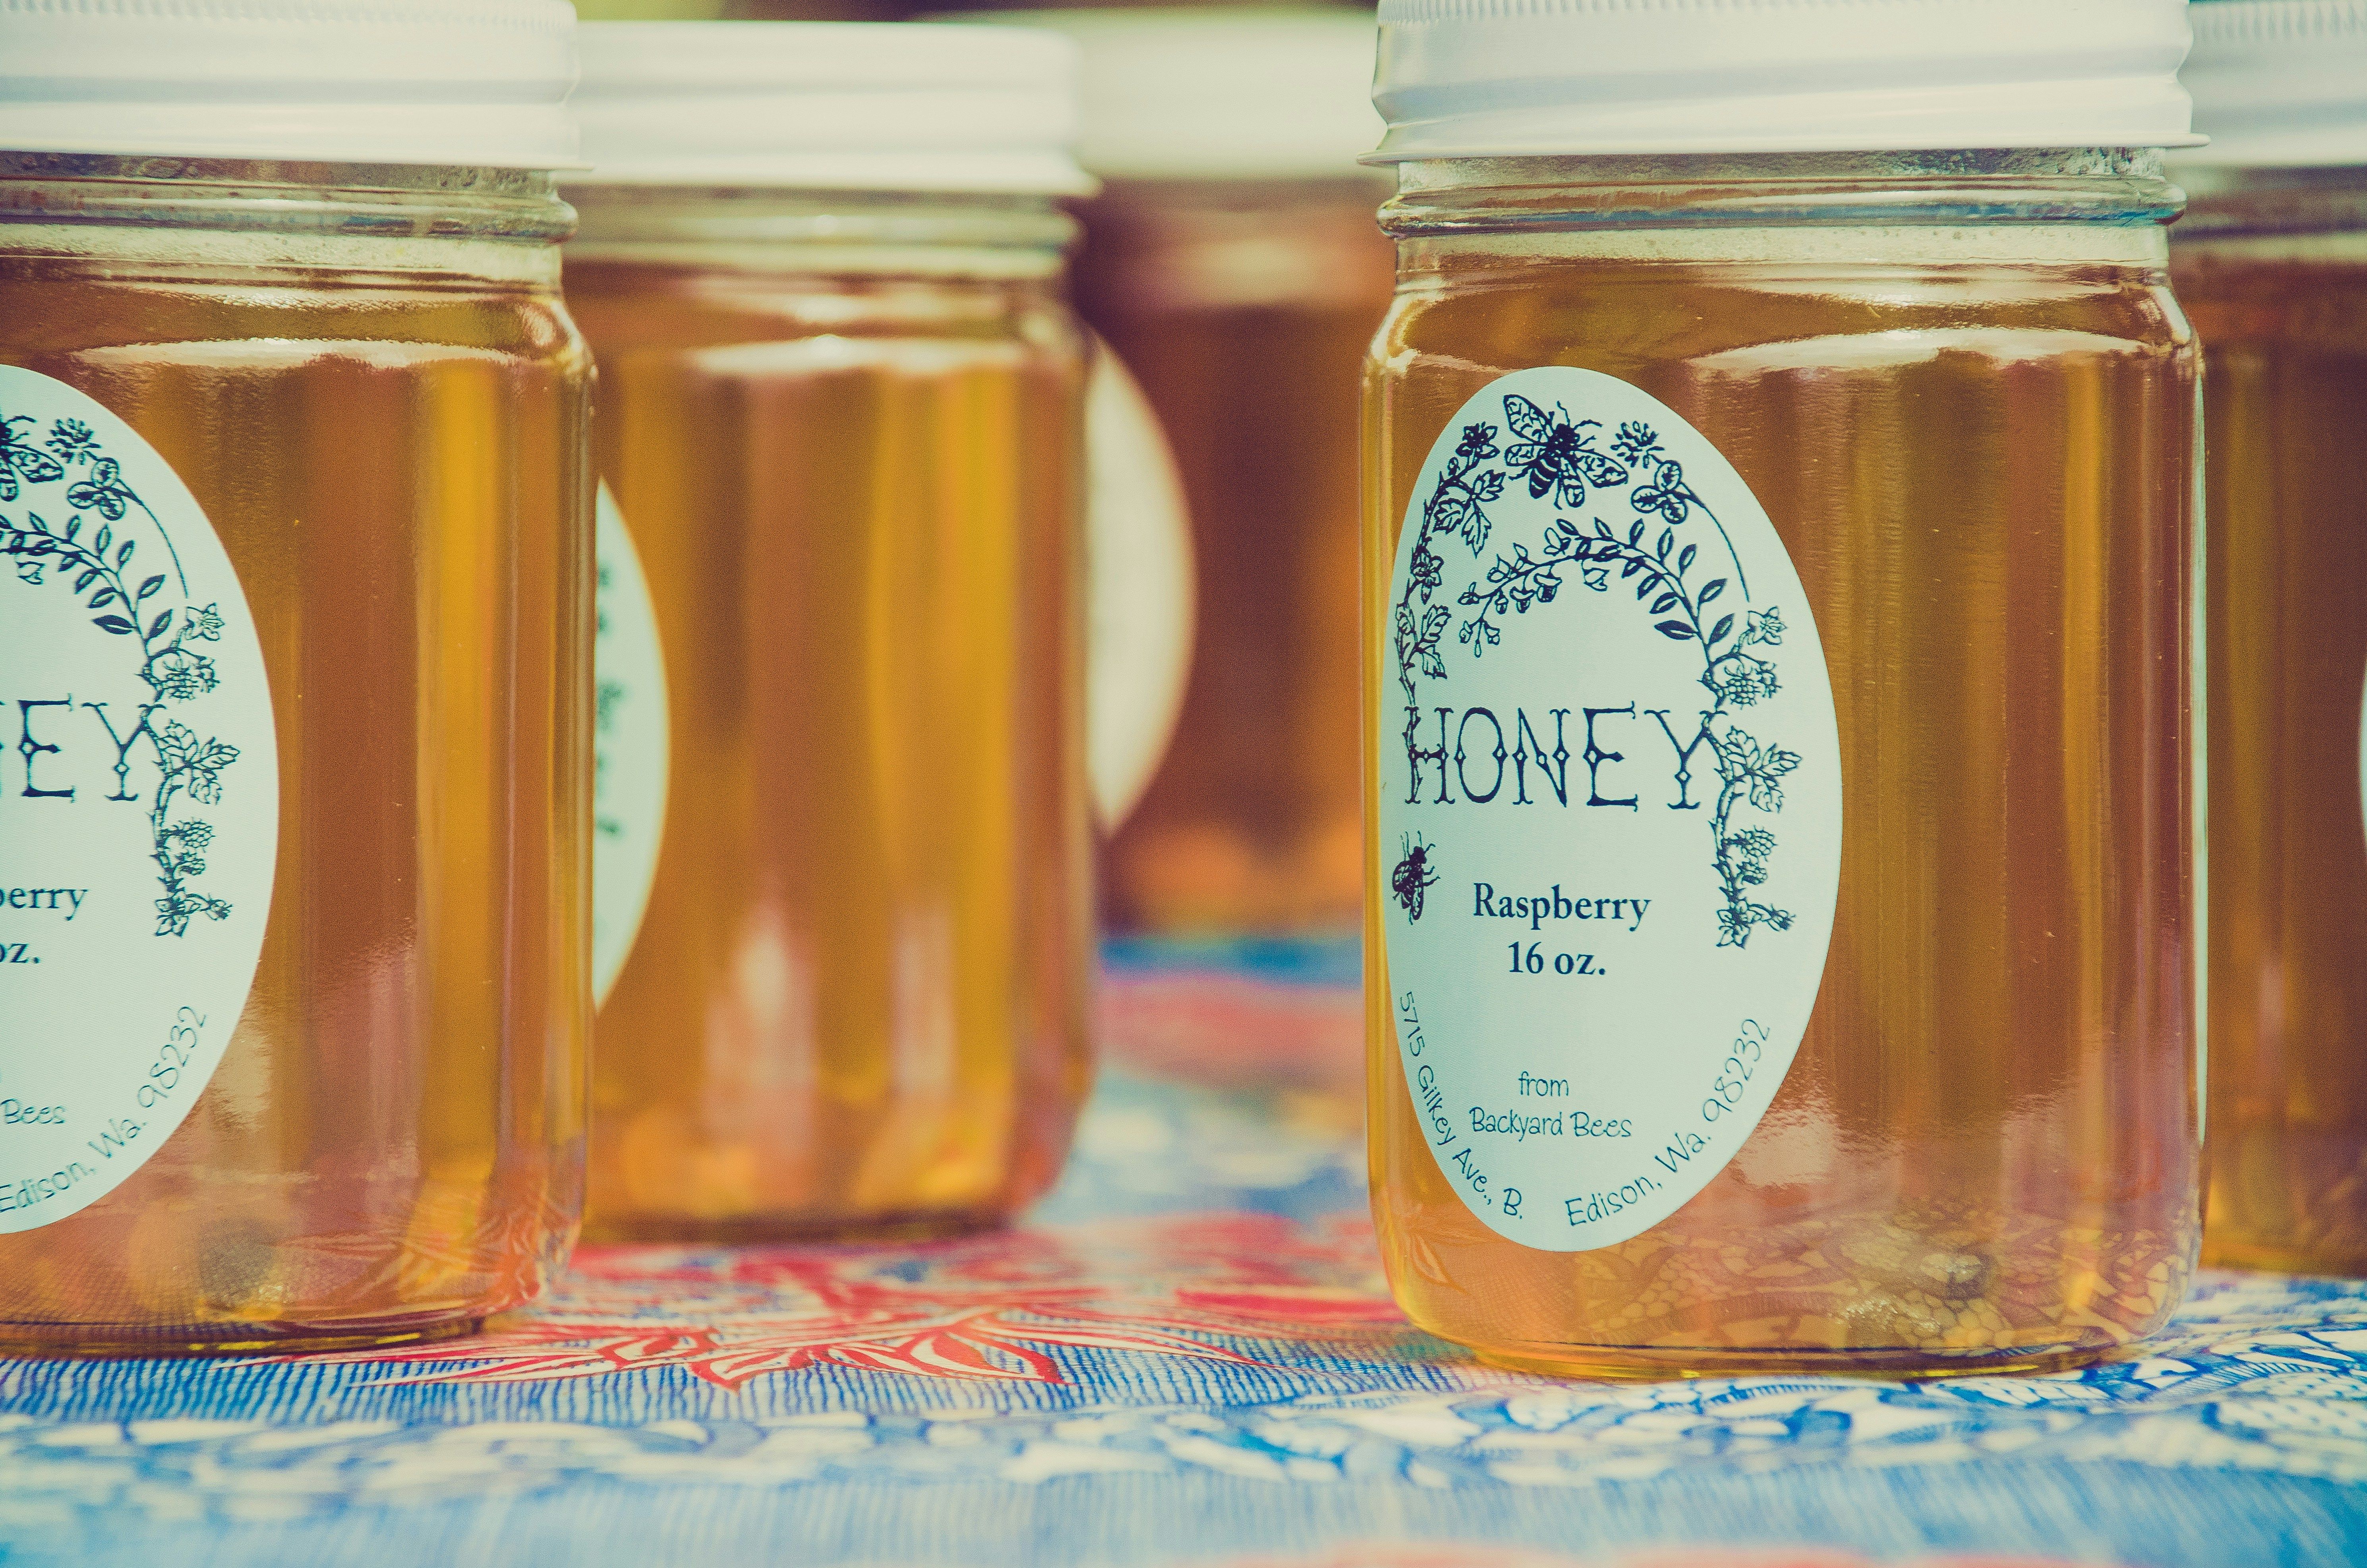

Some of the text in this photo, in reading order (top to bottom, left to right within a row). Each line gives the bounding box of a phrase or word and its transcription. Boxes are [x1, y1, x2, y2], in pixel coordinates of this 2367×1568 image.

[0, 692, 166, 803] EY
[1404, 701, 1728, 812] HONEY
[0, 888, 89, 921] erry
[1473, 882, 1652, 931] Raspberry
[1508, 941, 1605, 976] 16 oz.
[87, 1119, 147, 1159] Wa.
[137, 1006, 207, 1108] 98232
[1518, 1071, 1569, 1097] from
[0, 1098, 66, 1124] Bees
[1400, 991, 1770, 1226] 5715 Gilkey Ave., B. Edison, Wa. 98232
[1469, 1107, 1632, 1142] Backyard Bees
